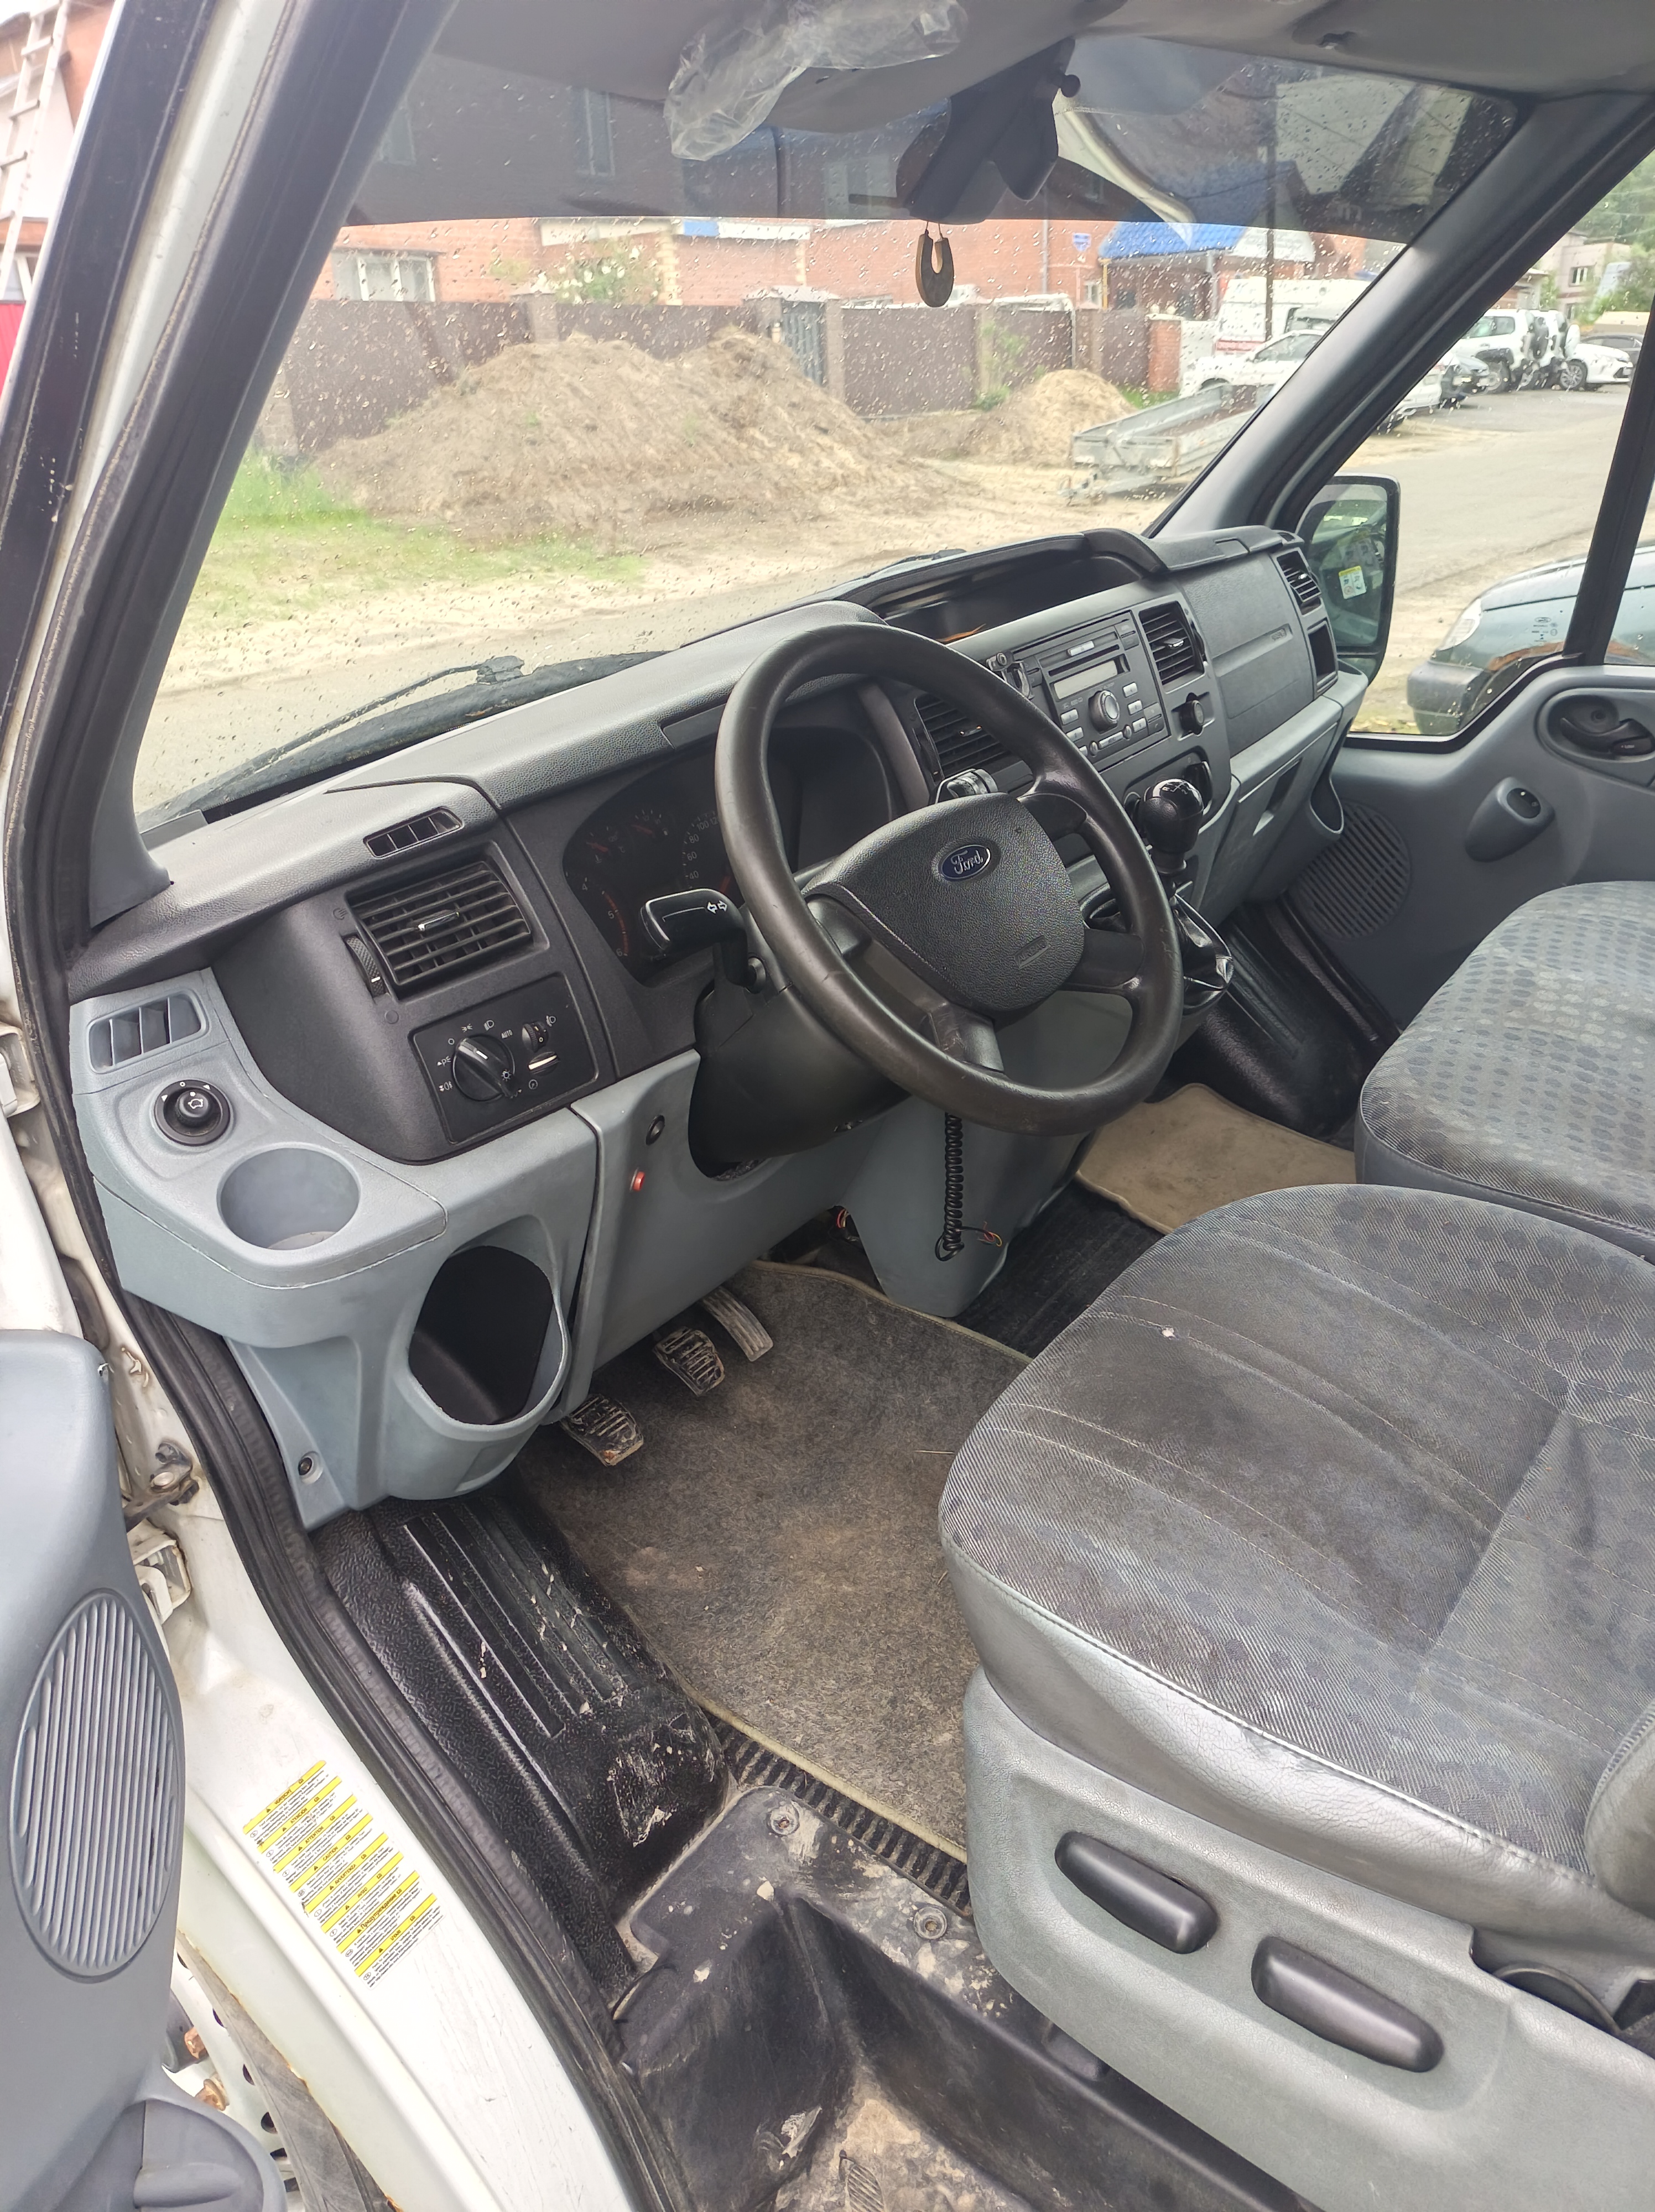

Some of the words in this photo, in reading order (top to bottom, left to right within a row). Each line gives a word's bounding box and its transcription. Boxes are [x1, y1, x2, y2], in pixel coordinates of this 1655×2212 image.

[696, 820, 710, 831] 100
[689, 833, 699, 844] 80
[686, 851, 697, 861] 60
[950, 849, 983, 874] Ford
[689, 870, 699, 879] 40
[582, 882, 588, 891] 4
[608, 910, 615, 919] 5
[616, 948, 623, 957] 6
[501, 1029, 513, 1039] AUTO
[322, 1846, 339, 1861] CAUTION
